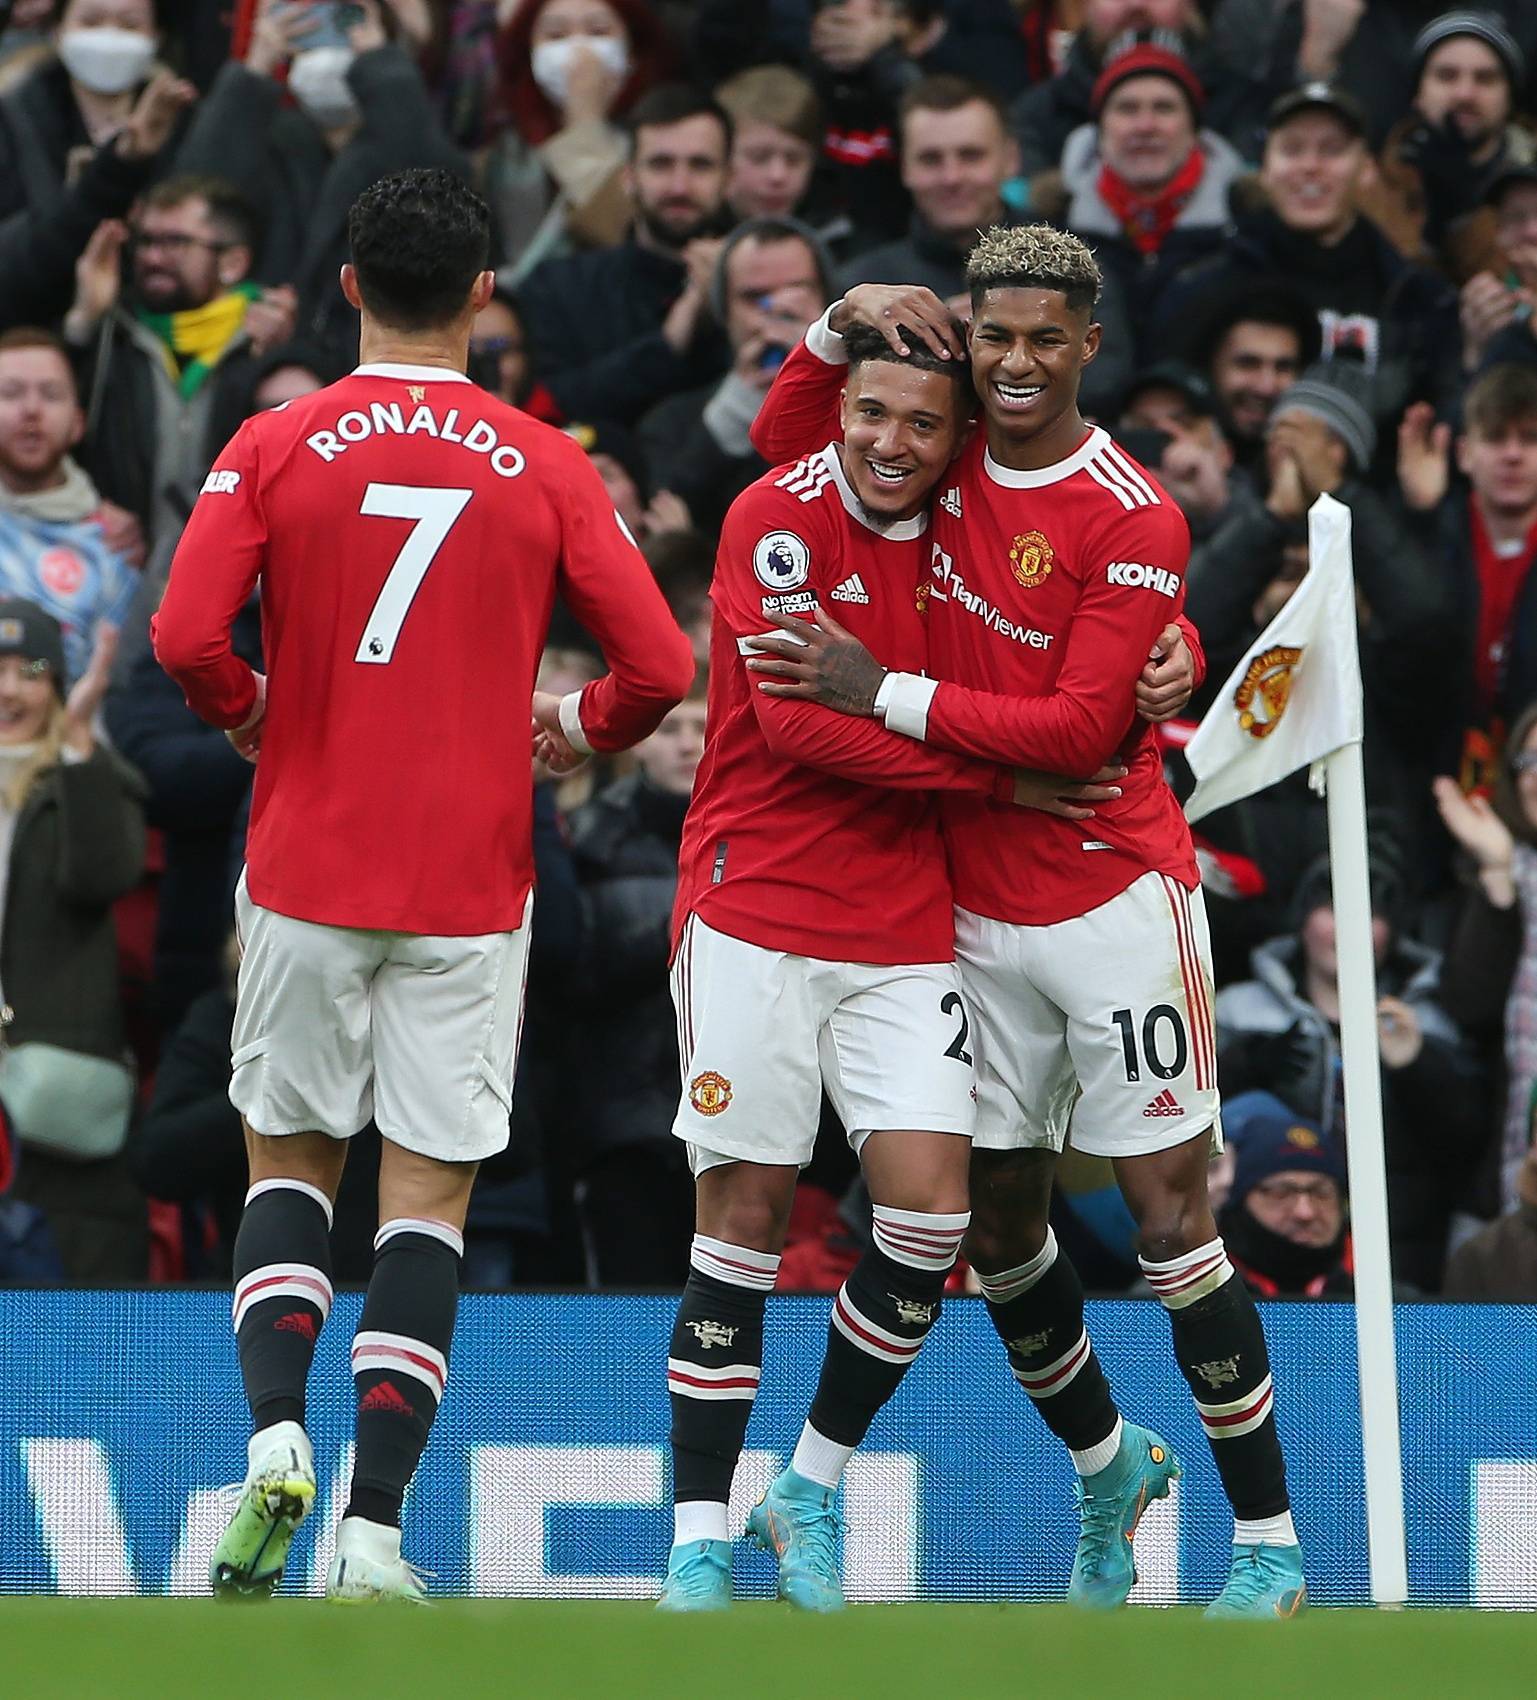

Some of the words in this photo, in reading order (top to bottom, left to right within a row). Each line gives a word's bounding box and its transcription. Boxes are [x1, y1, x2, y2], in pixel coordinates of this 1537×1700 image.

[305, 401, 527, 478] RONALDO
[354, 482, 475, 665] 7
[1107, 562, 1180, 598] KOHLE
[761, 595, 780, 608] No
[781, 592, 812, 605] room
[782, 600, 819, 614] racism
[831, 590, 870, 605] adidas
[1111, 1003, 1188, 1082] 10
[1143, 1107, 1185, 1118] adidas
